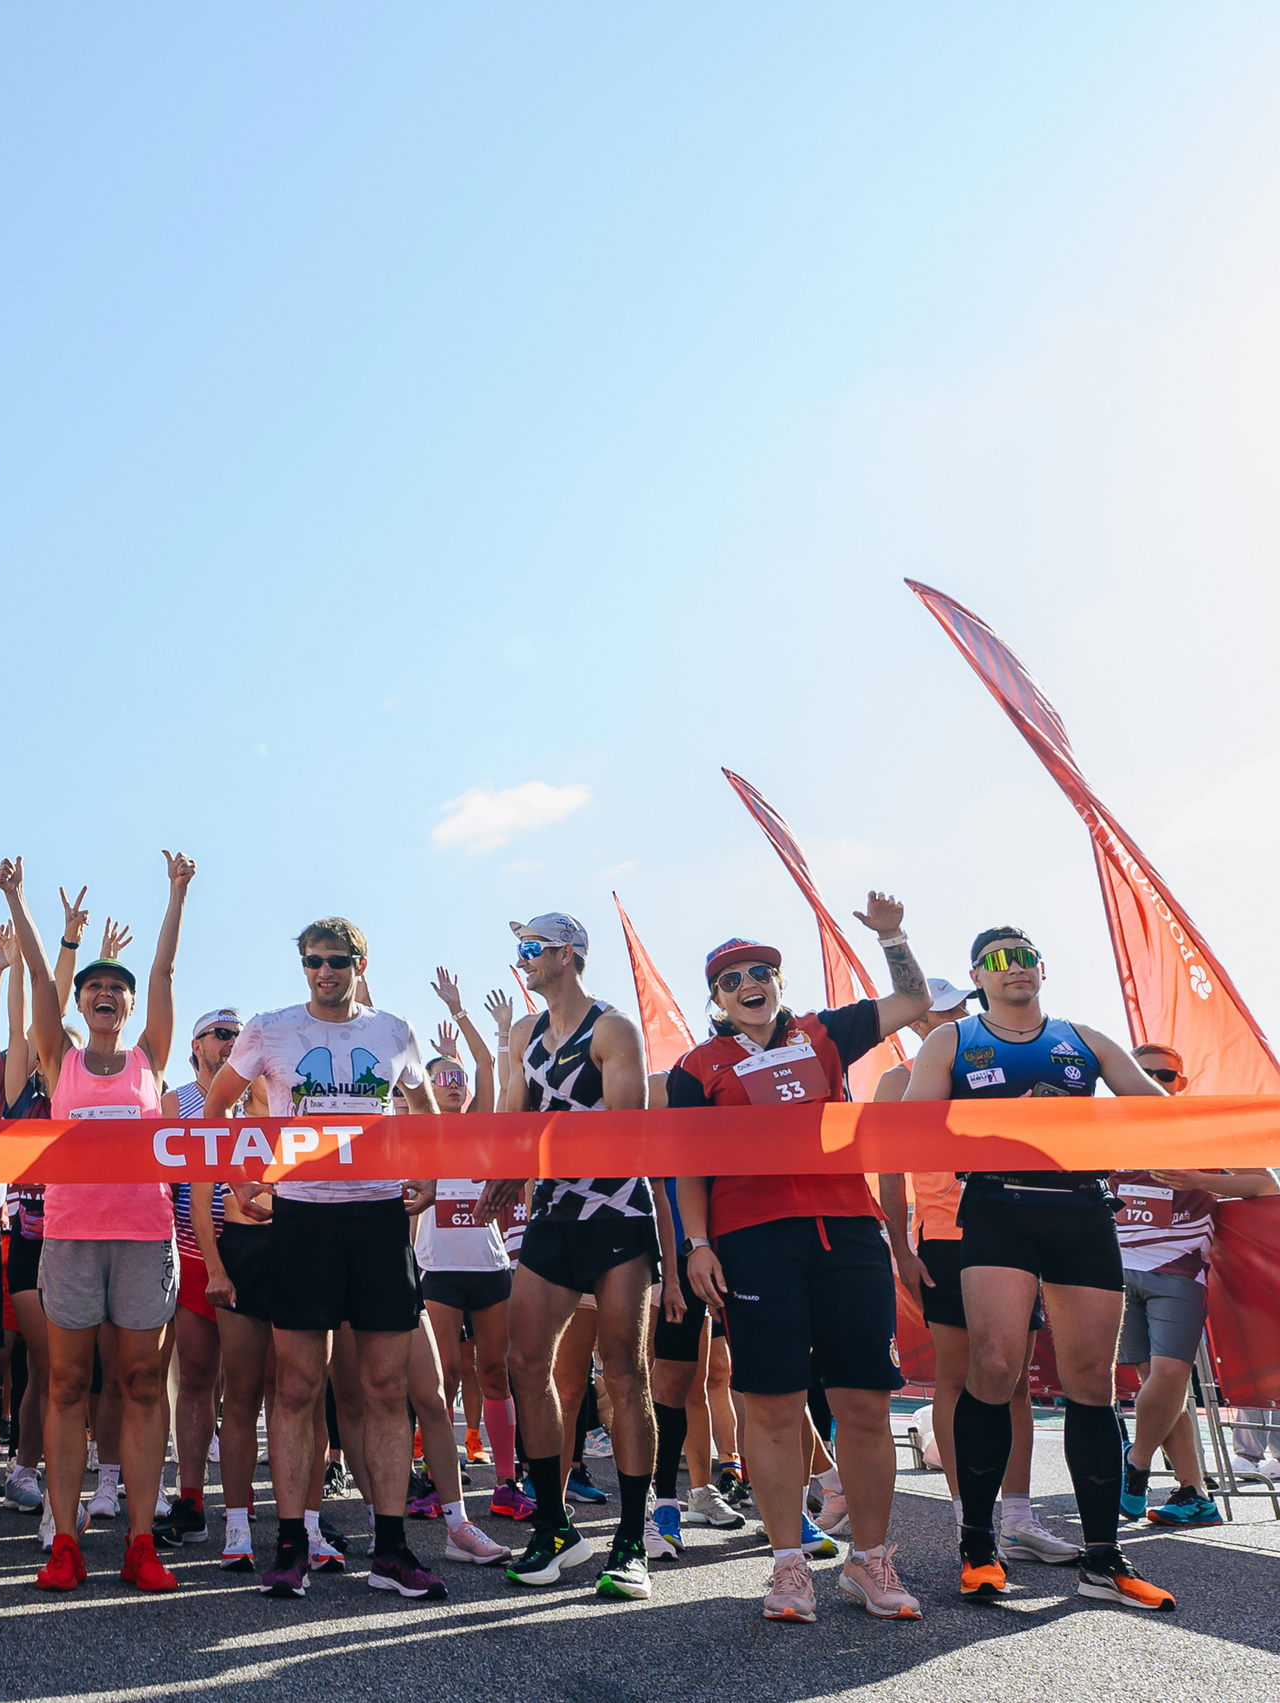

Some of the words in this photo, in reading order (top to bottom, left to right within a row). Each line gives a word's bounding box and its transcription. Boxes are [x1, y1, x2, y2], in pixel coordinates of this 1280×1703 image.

[775, 1080, 806, 1101] 33
[152, 1125, 364, 1167] СТАРТ
[1126, 1208, 1153, 1223] 170
